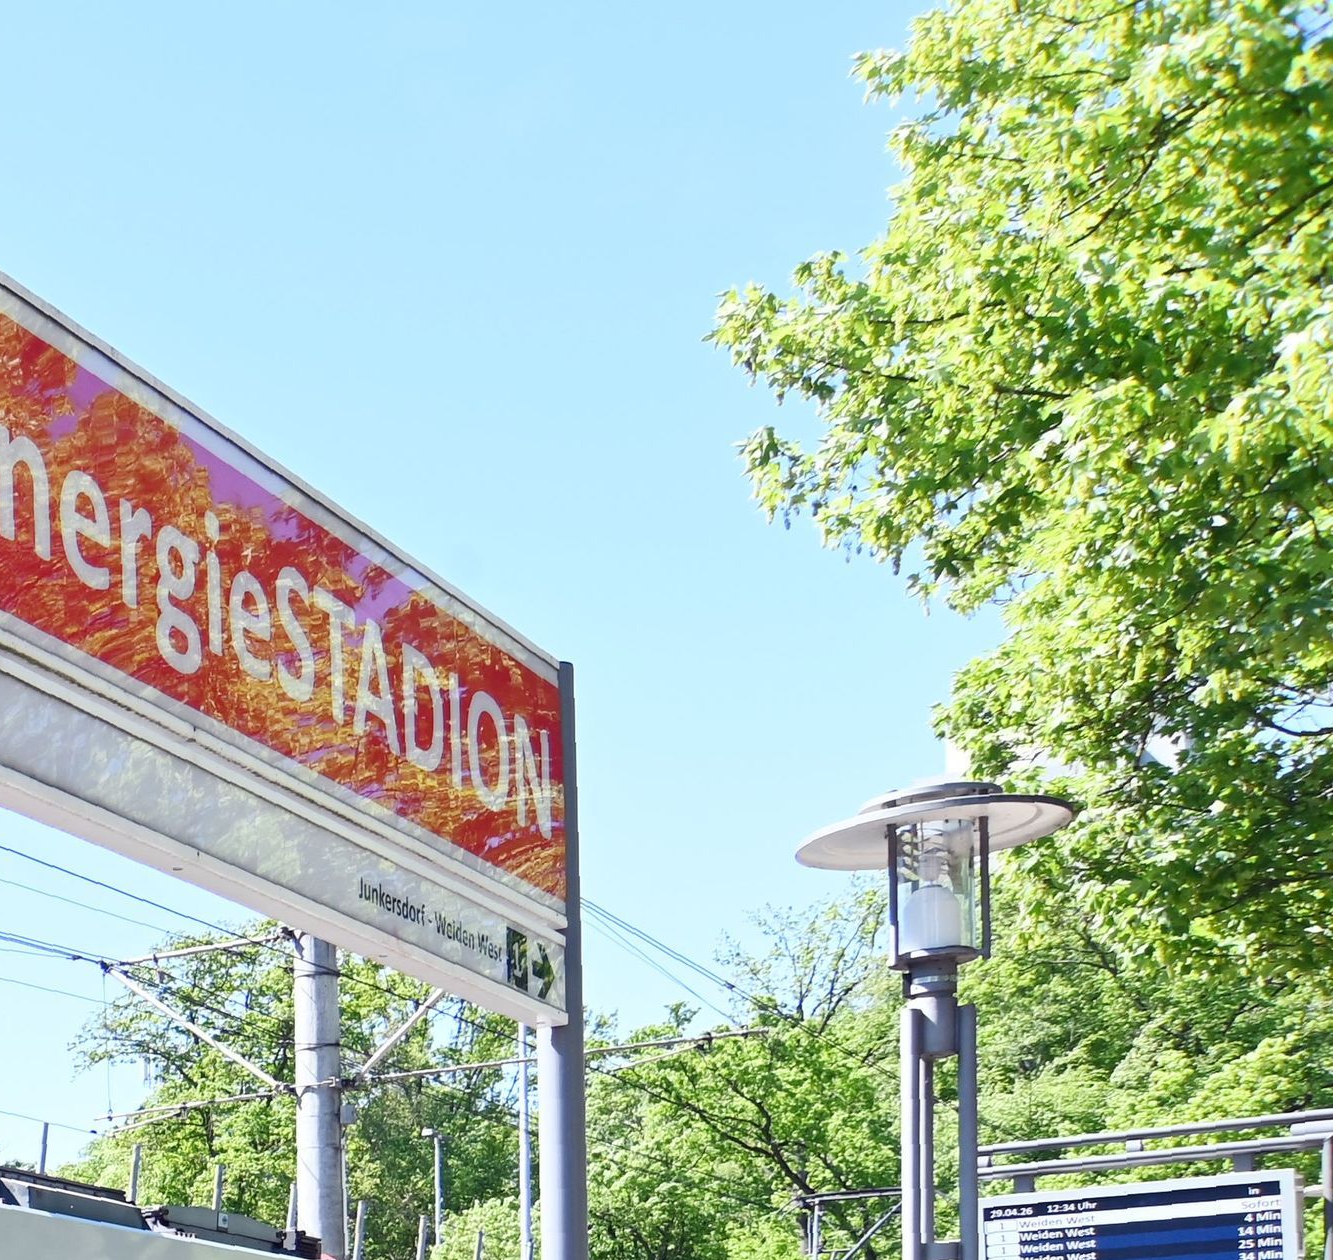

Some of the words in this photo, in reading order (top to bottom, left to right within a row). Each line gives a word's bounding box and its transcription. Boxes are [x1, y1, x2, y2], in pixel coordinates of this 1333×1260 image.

[358, 877, 426, 927] Junkersdorf
[434, 912, 475, 949] Weiden
[478, 930, 502, 963] West
[990, 1207, 1033, 1218] 29.04.26
[1047, 1203, 1076, 1213] 12:34
[1077, 1202, 1097, 1211] Uhr
[1248, 1187, 1260, 1195] in
[1019, 1219, 1062, 1229] Weiden
[1067, 1215, 1095, 1225] West
[1242, 1200, 1280, 1210] Sofort
[1020, 1231, 1063, 1241] Weiden
[1065, 1227, 1095, 1238] West
[1244, 1213, 1253, 1222] 4
[1256, 1211, 1281, 1222] Min
[1020, 1243, 1064, 1253] Weiden
[1066, 1239, 1096, 1250] West
[1237, 1226, 1254, 1236] 14
[1256, 1224, 1281, 1235] Min
[1238, 1239, 1255, 1249] 25
[1258, 1237, 1282, 1248] Min
[1258, 1250, 1282, 1260] Min
